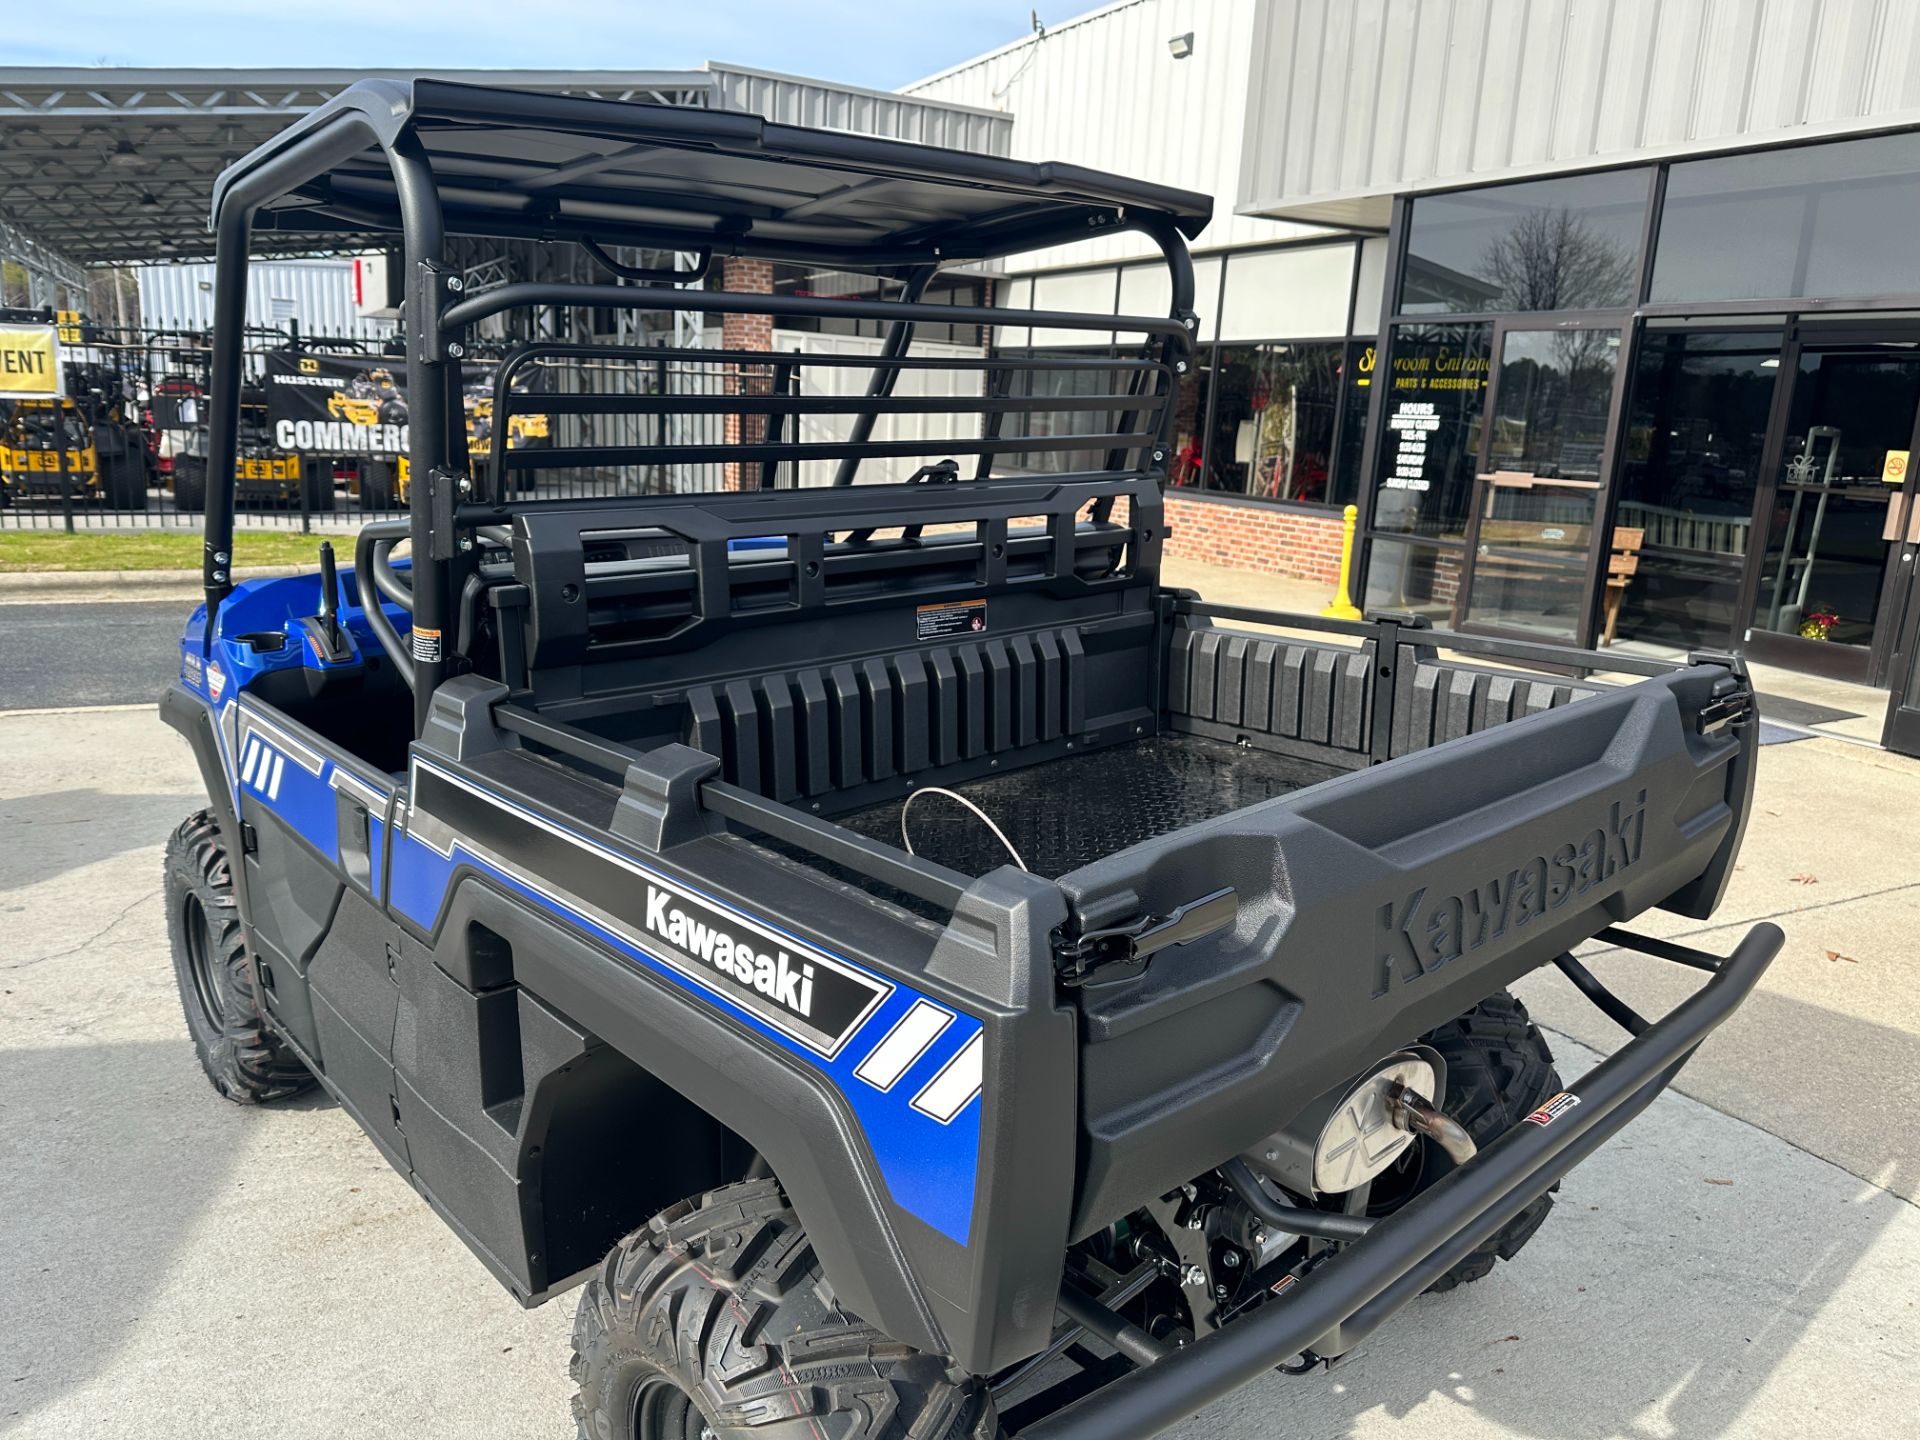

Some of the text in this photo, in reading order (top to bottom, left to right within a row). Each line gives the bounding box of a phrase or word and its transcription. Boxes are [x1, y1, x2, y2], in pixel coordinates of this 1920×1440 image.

[0, 349, 45, 374] ENT
[273, 375, 345, 387] HUSTLER
[1395, 377, 1479, 391] PARTS & ACCESSORIES
[1399, 403, 1434, 415] HOURS
[1371, 788, 1647, 1000] Kawasaki
[646, 885, 815, 1018] Kawasaki
